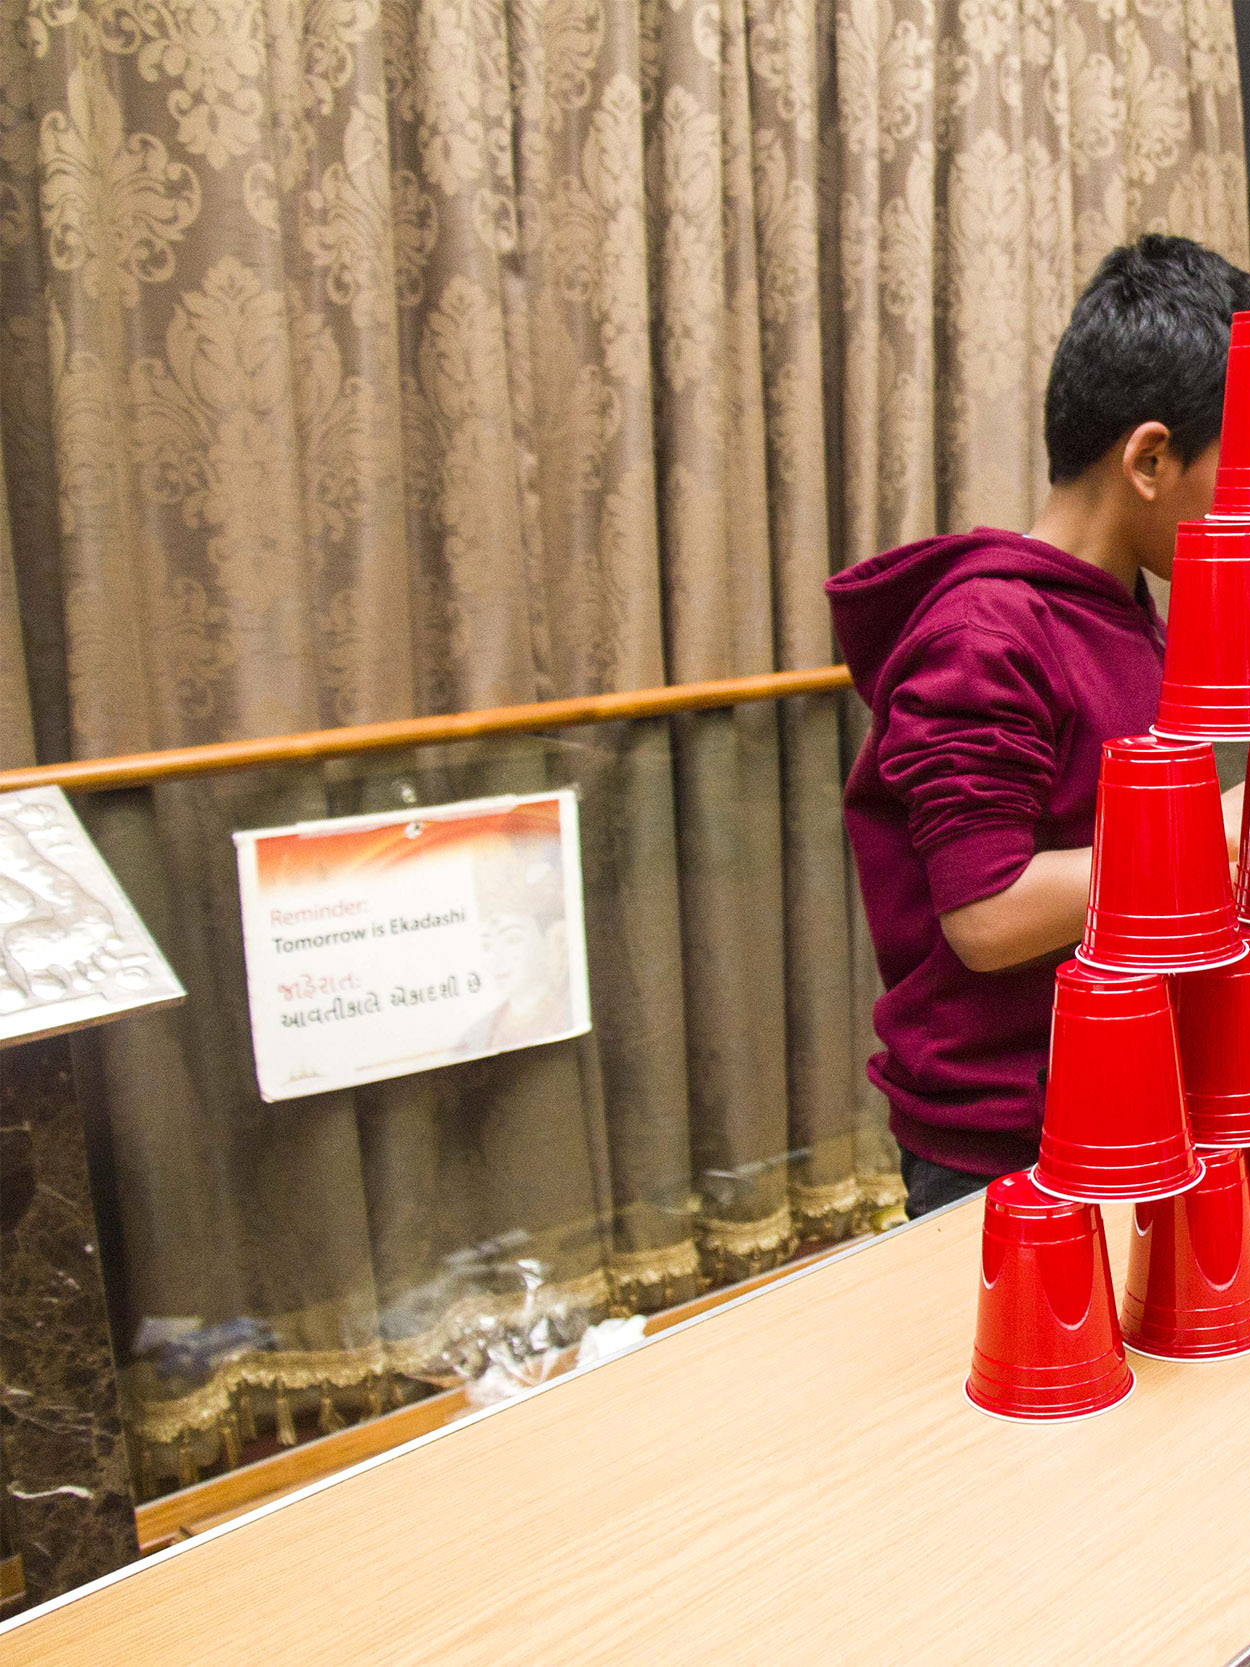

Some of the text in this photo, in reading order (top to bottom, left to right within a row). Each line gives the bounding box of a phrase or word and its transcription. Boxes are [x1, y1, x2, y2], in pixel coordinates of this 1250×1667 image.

[270, 899, 369, 926] Reminder:
[272, 906, 467, 954] Tomorrow is Ekadashi
